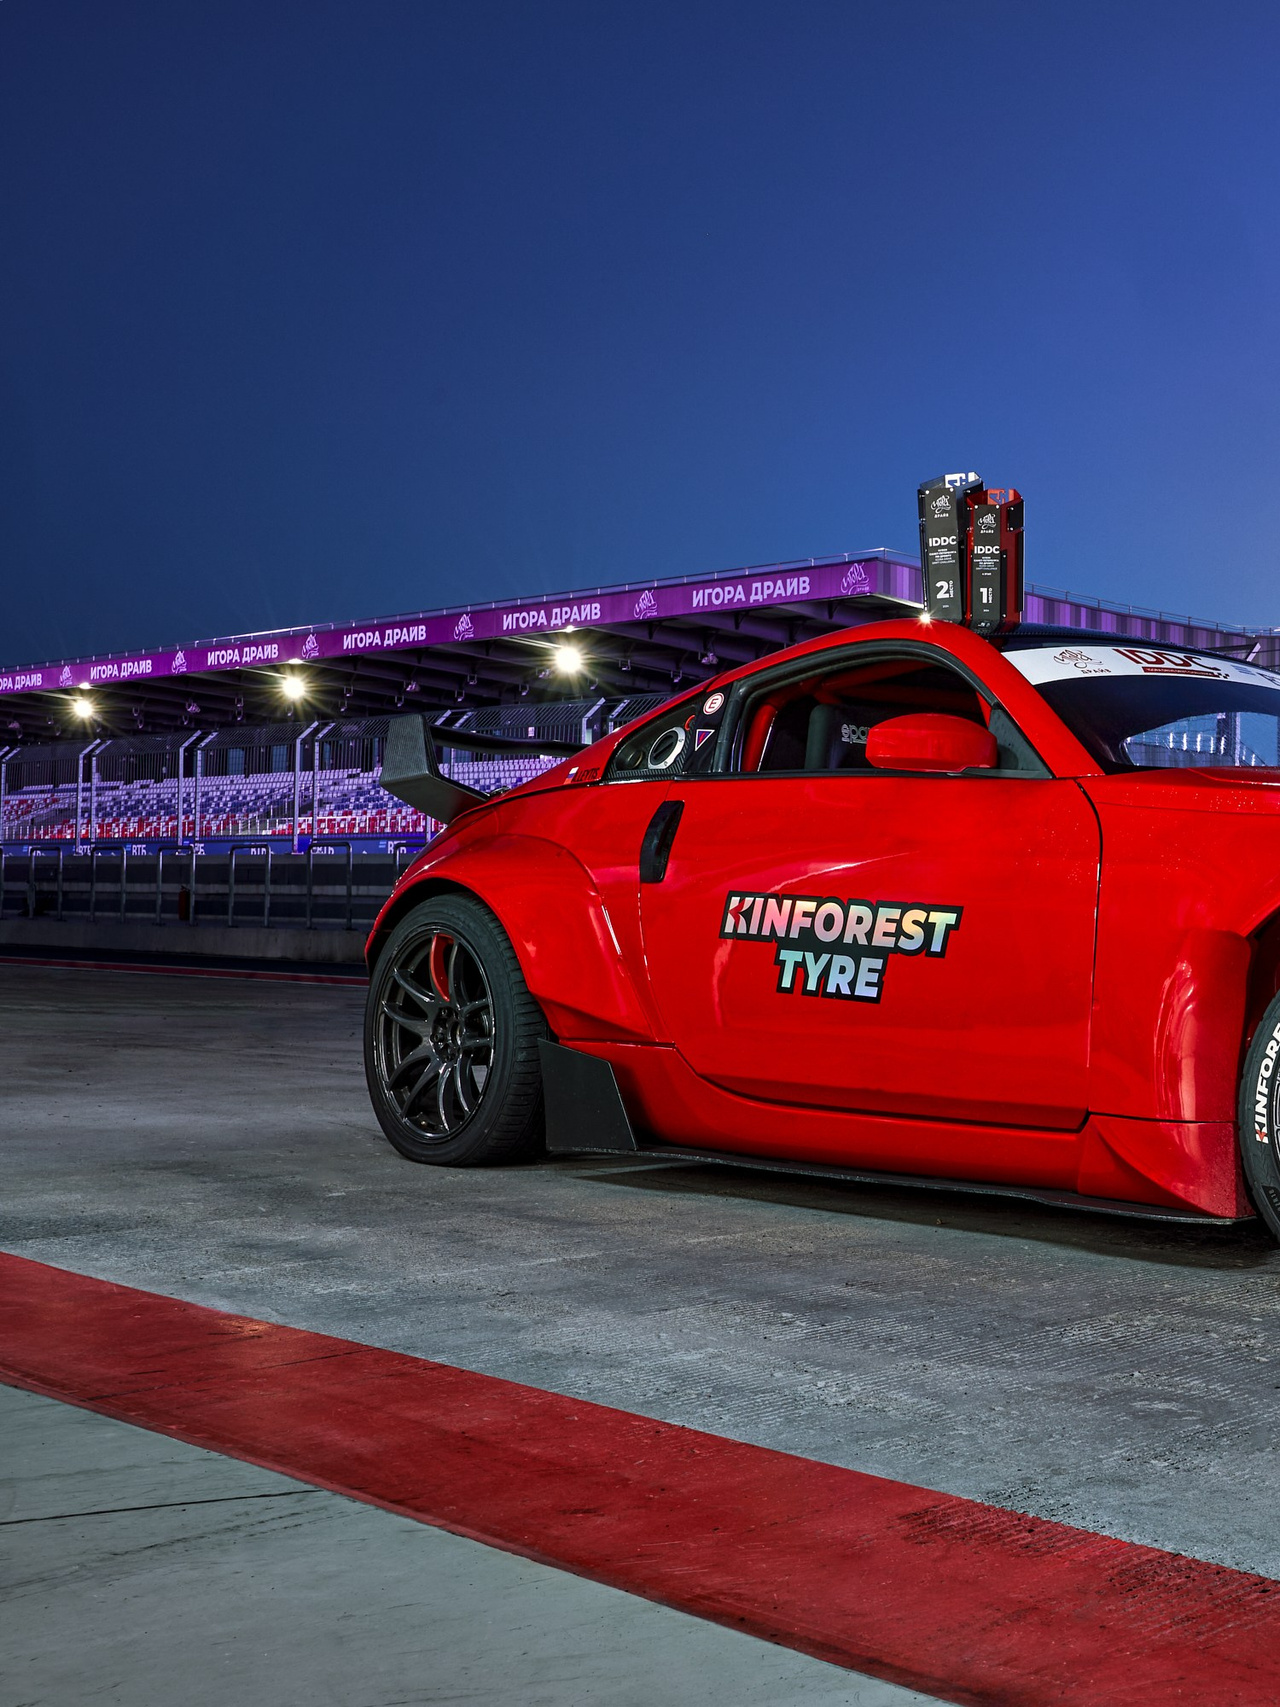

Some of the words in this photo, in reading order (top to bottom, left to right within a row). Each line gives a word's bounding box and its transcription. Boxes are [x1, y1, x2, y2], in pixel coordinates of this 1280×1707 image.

[928, 535, 957, 547] IDDC
[974, 545, 1000, 554] IDDC
[692, 584, 746, 608] ИГОРА
[749, 576, 810, 602] ДРАЙВ
[935, 581, 950, 599] 2
[980, 587, 988, 604] 1
[503, 609, 548, 631] ИГОРА
[550, 602, 601, 627] ДРАЙВ
[343, 631, 381, 650] ИГОРА
[383, 625, 427, 647] ДРАЙВ
[207, 649, 240, 666] ИГОРА
[241, 643, 279, 663] ДРАЙВ
[1112, 648, 1221, 671] IDDC
[90, 664, 119, 680] ИГОРА
[120, 659, 152, 678] ДРАЙВ
[14, 673, 43, 690] ДРАЙВ
[724, 896, 957, 953] KINFOREST
[778, 949, 884, 998] TYRE
